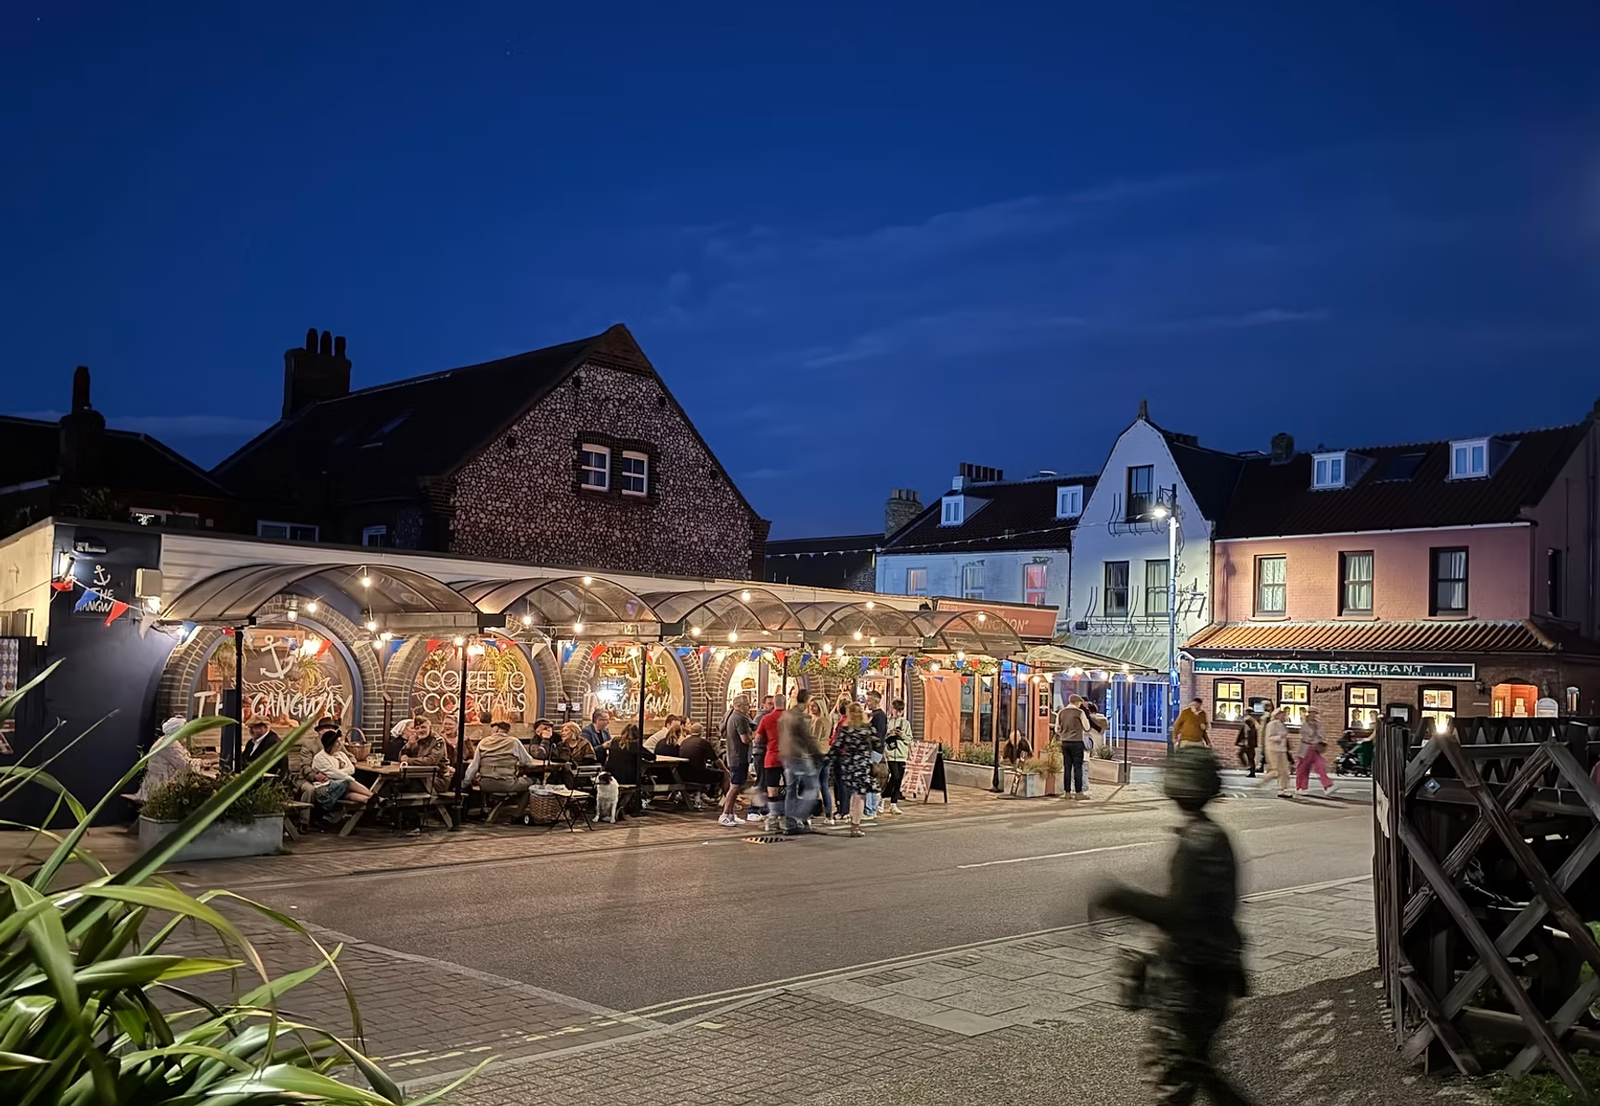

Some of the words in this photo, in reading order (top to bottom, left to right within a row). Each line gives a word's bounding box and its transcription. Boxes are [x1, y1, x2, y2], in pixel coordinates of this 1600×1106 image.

[1232, 661, 1272, 670] JOLLY
[1281, 662, 1309, 671] TAR
[1319, 662, 1423, 673] RESTAURANT
[504, 671, 526, 691] TO
[194, 690, 223, 718] TH
[251, 690, 352, 720] GANGWAY
